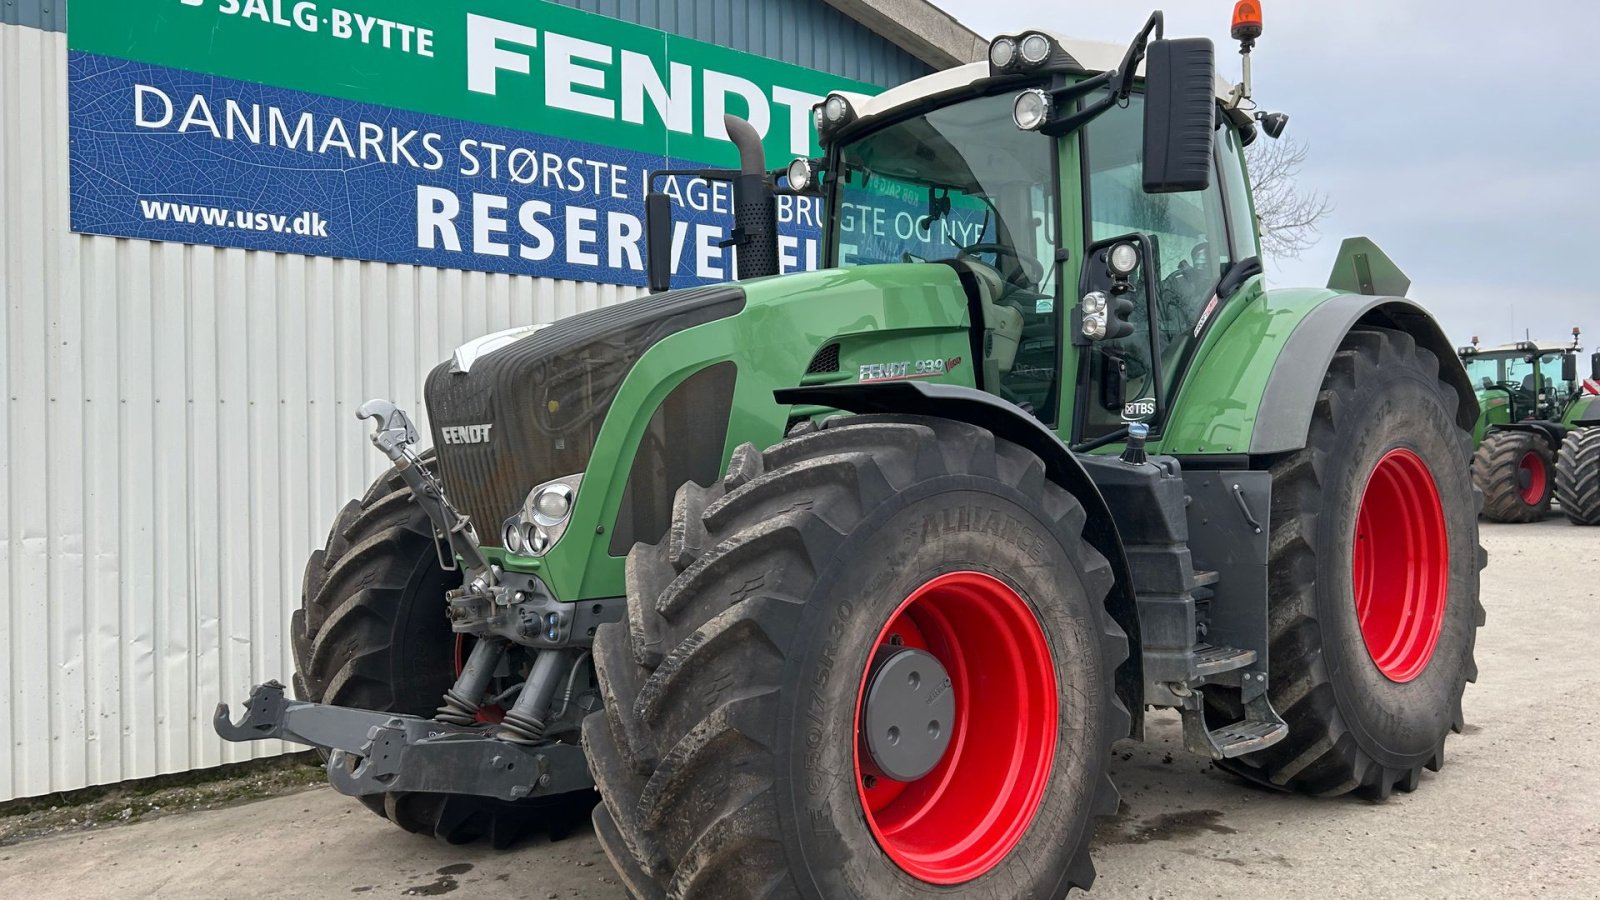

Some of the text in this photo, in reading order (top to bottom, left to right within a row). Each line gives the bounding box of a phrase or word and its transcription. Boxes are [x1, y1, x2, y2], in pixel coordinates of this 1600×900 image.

[466, 13, 822, 157] FENDT
[134, 83, 443, 170] DANMARKS
[460, 139, 627, 199] STØRSTE
[642, 168, 736, 215] LAGE
[140, 200, 328, 237] www.usv.dk
[860, 361, 910, 380] FENDT
[915, 358, 944, 374] 939
[1133, 402, 1154, 414] TBS
[441, 423, 493, 445] FENDT
